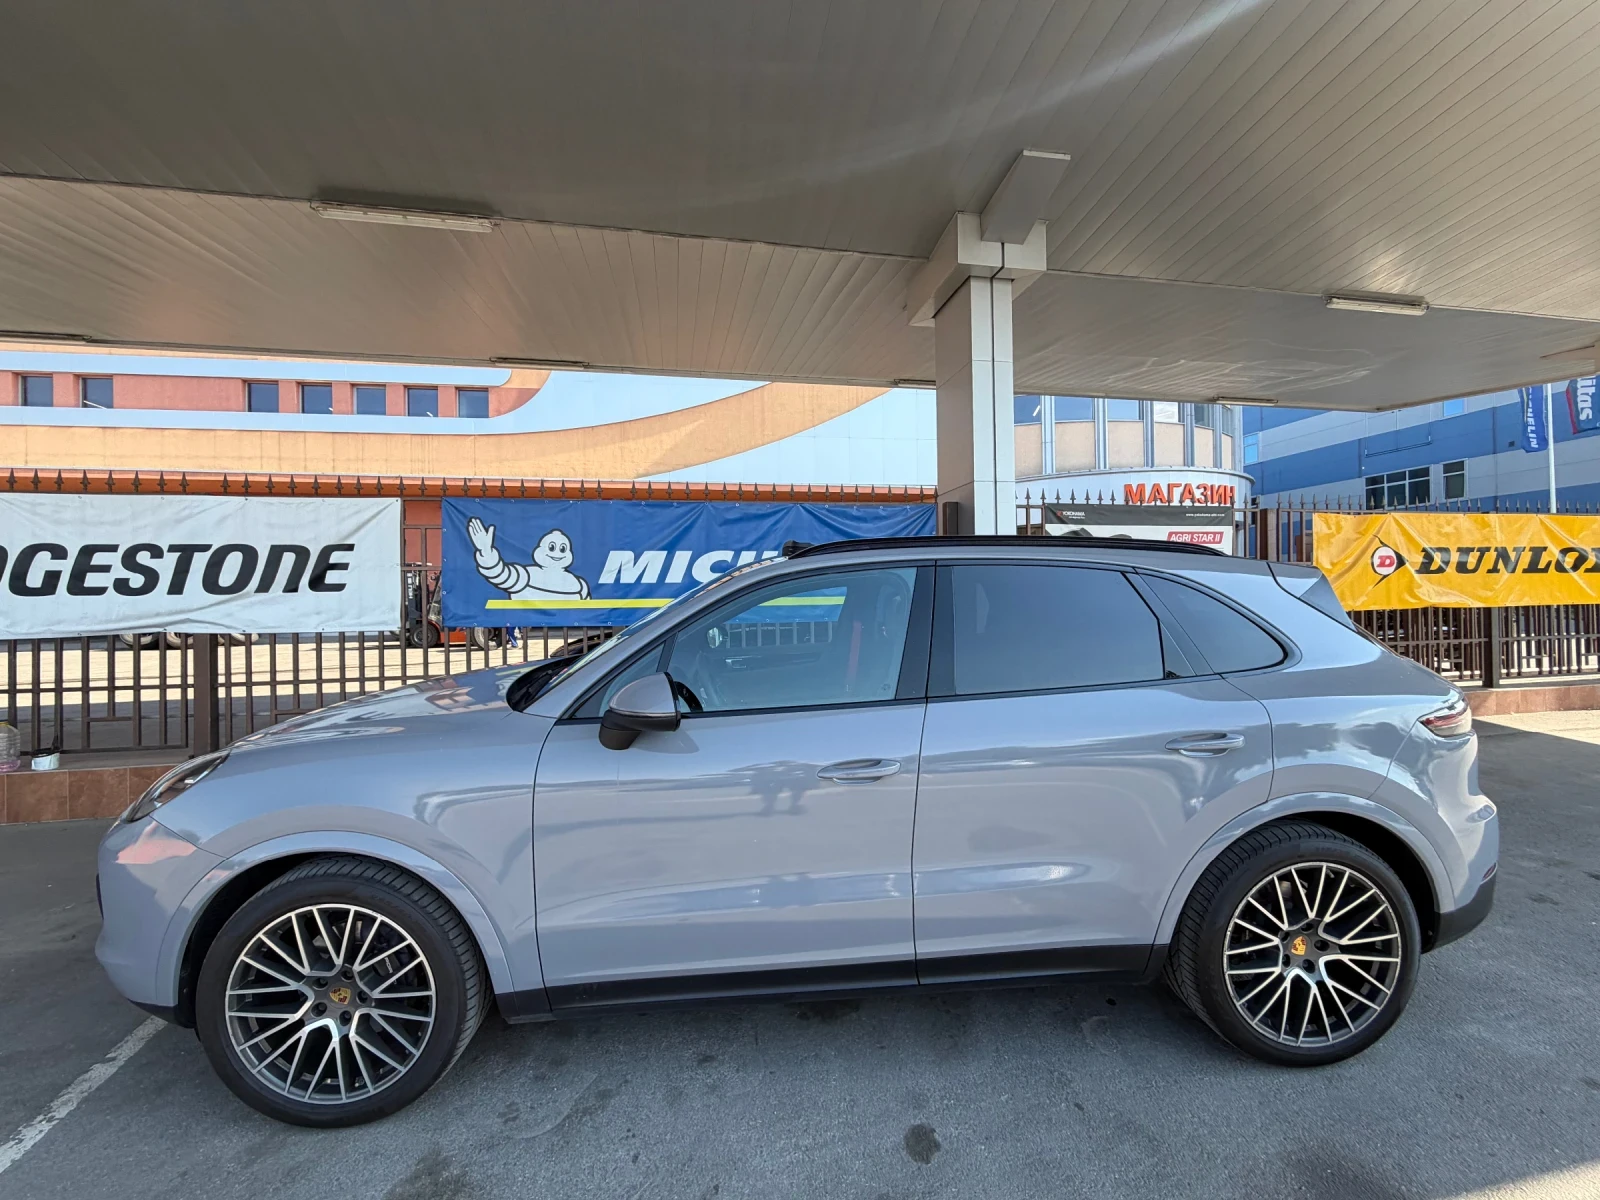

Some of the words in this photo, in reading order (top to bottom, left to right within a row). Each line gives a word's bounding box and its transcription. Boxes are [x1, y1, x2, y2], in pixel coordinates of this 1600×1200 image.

[1577, 375, 1596, 421] itas
[1123, 483, 1236, 505] МАГАЗИН
[1170, 533, 1191, 542] AGRI
[1192, 533, 1214, 543] STAR
[1215, 533, 1221, 542] II
[0, 542, 355, 597] GESTONE
